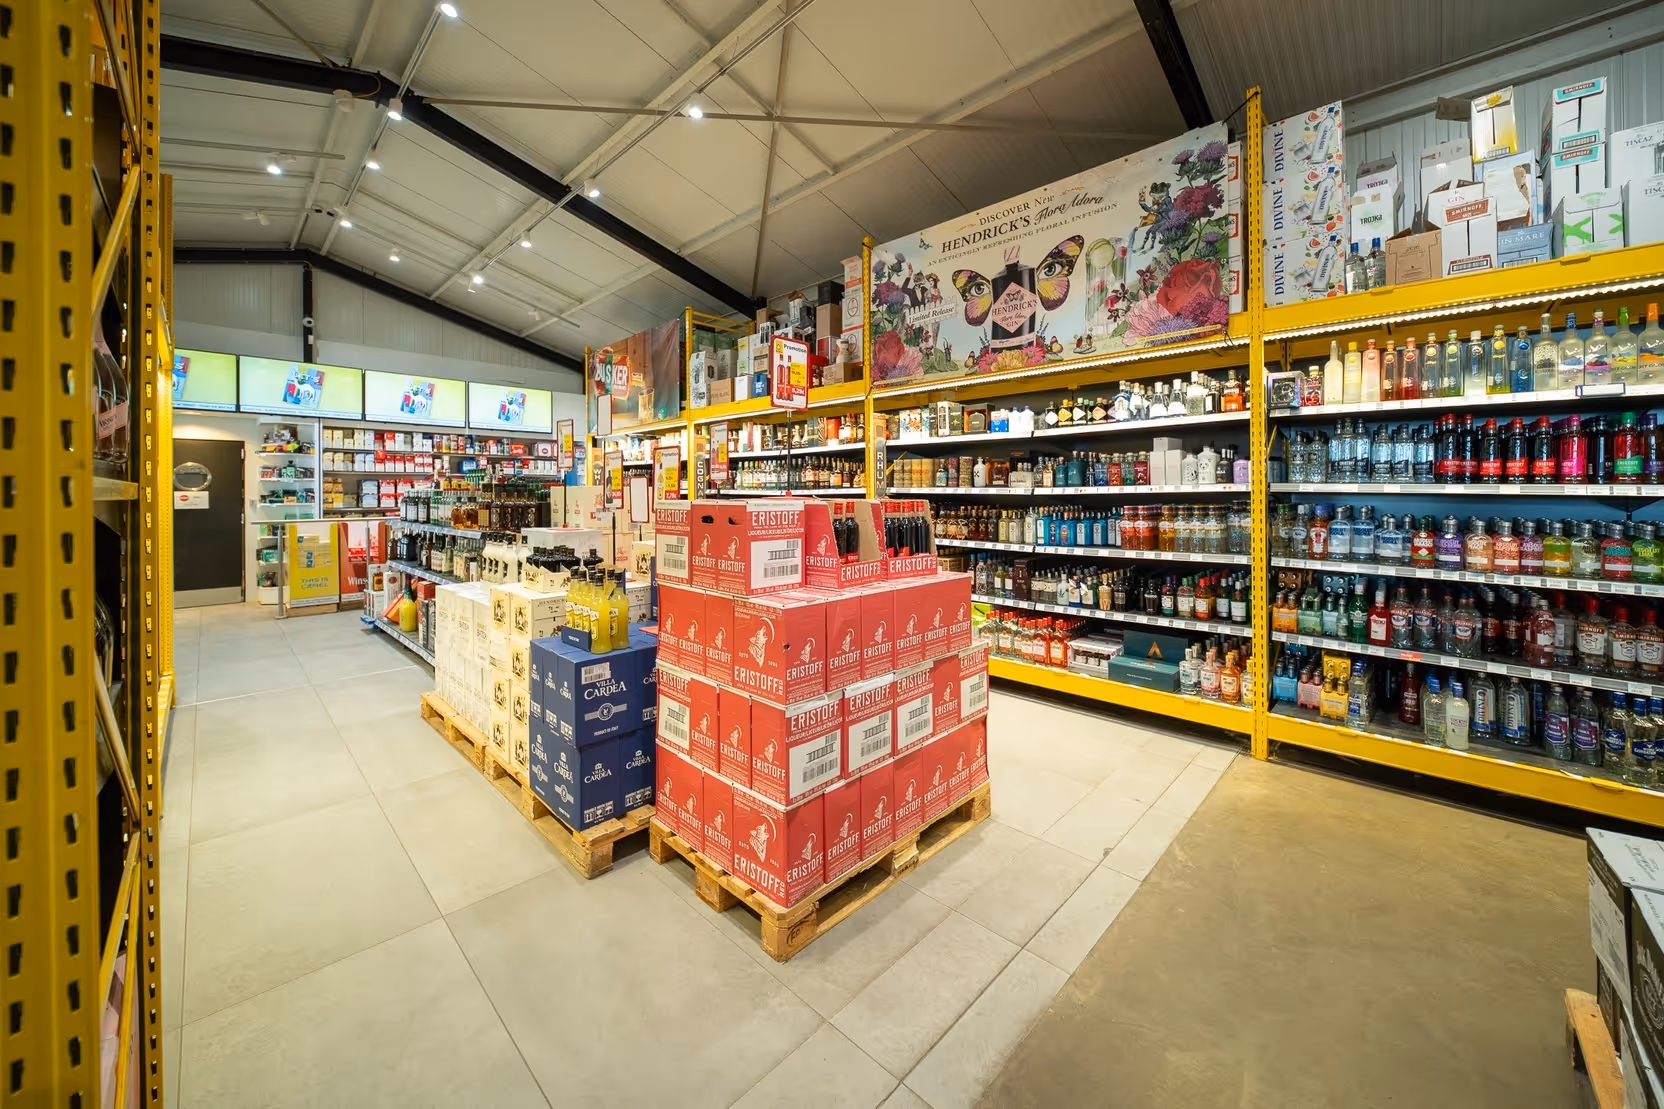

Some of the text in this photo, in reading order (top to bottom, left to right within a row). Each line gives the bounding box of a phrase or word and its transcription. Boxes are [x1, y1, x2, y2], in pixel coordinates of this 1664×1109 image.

[1274, 129, 1285, 173] DIVINE
[1447, 194, 1465, 203] GIN
[979, 194, 1055, 226] DISCOVER New
[1035, 219, 1070, 234] FLORAL
[1071, 202, 1118, 222] INFUSION
[1273, 187, 1284, 231] DIVINE
[1451, 204, 1483, 216] SMIRNOFF
[941, 193, 1104, 253] HENDRICK'S Flora Adora
[1515, 231, 1546, 244] MARE
[1274, 252, 1285, 296] DIVINE
[908, 306, 955, 324] Limited Release
[992, 299, 1038, 316] HENDRICK'S
[783, 343, 807, 353] Promotion
[595, 362, 628, 386] BUSKER
[696, 461, 704, 499] COGNA
[876, 451, 884, 489] RHUM
[656, 509, 687, 522] ERISTOFF
[752, 511, 800, 526] ERISTOFF
[692, 556, 716, 569] ERISTOFF
[718, 559, 746, 573] ERISTOFF
[806, 555, 838, 568] ERISTOFF
[889, 557, 932, 573] ERISTOFF
[841, 562, 877, 582] ERISTOFF
[924, 627, 948, 642] ERISTOFF
[949, 620, 971, 635] ERISTOFF
[659, 632, 678, 648] ERISTOFF
[680, 639, 704, 656] ERISTOFF
[897, 633, 923, 650] ERISTOFF
[705, 646, 732, 664] ERISTOFF
[829, 650, 861, 669] ERISTOFF
[864, 642, 893, 659] ERISTOFF
[960, 649, 986, 669] ERISTOFF
[659, 669, 689, 693] ERISTOFF
[734, 665, 779, 693] ERISTOFF
[786, 661, 824, 681] ERISTOFF
[897, 669, 931, 692] ERISTOFF
[584, 681, 627, 700] CARDEA
[596, 678, 616, 688] VILLA
[850, 685, 890, 711] ERISTOFF
[934, 699, 958, 717] ERISTOFF
[791, 701, 840, 731] ERISTOFF
[692, 730, 716, 750] ERISTOFF
[625, 756, 651, 770] CARDEA
[720, 743, 748, 765] ERISTOFF
[584, 769, 613, 784] CARDEA
[752, 757, 786, 781] ERISTOFF
[949, 768, 970, 788] ERISTOFF
[657, 791, 678, 813] ERISTOFF
[924, 784, 947, 803] ERISTOFF
[895, 797, 922, 820] ERISTOFF
[678, 808, 702, 831] ERISTOFF
[863, 814, 892, 839] ERISTOFF
[704, 825, 732, 850] ERISTOFF
[827, 833, 860, 860] ERISTOFF
[734, 853, 781, 893] ERISTOFF
[786, 852, 824, 883] ERISTOFF
